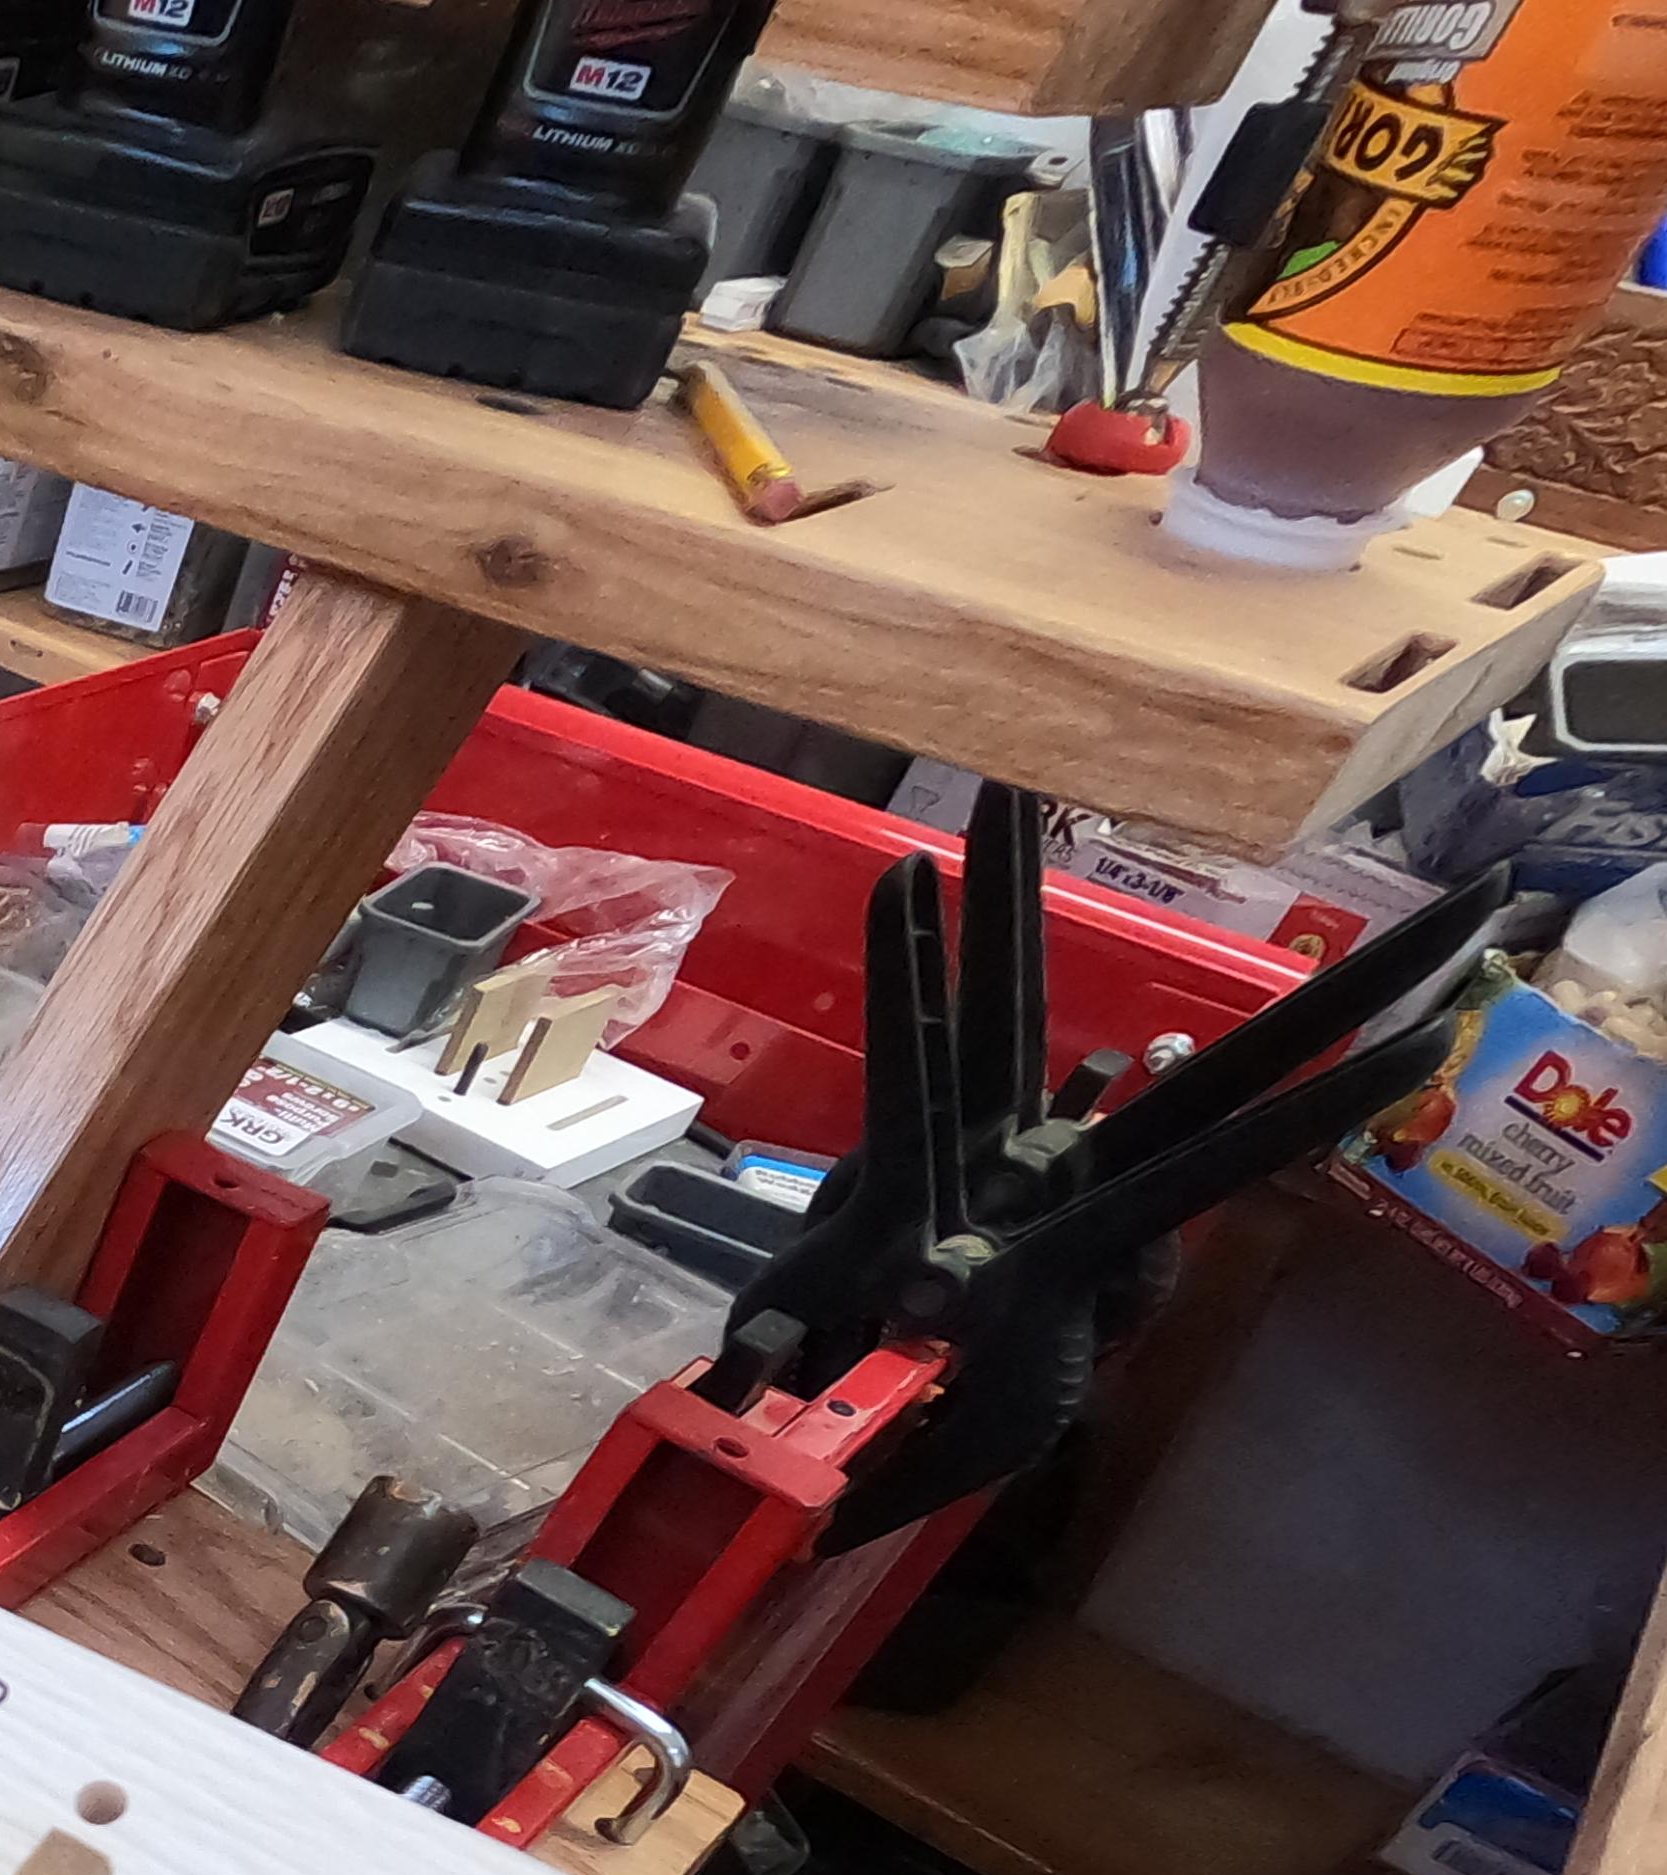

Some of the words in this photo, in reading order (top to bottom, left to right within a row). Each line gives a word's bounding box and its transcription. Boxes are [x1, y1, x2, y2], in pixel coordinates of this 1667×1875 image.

[100, 51, 167, 78] LITHIUM
[575, 63, 644, 92] M12
[532, 125, 614, 152] LITHIUM
[1514, 1050, 1634, 1148] Dole
[221, 1110, 285, 1145] GRK
[1502, 1122, 1576, 1175] cherry
[1457, 1133, 1529, 1183] mixed
[1524, 1173, 1577, 1216] fruit
